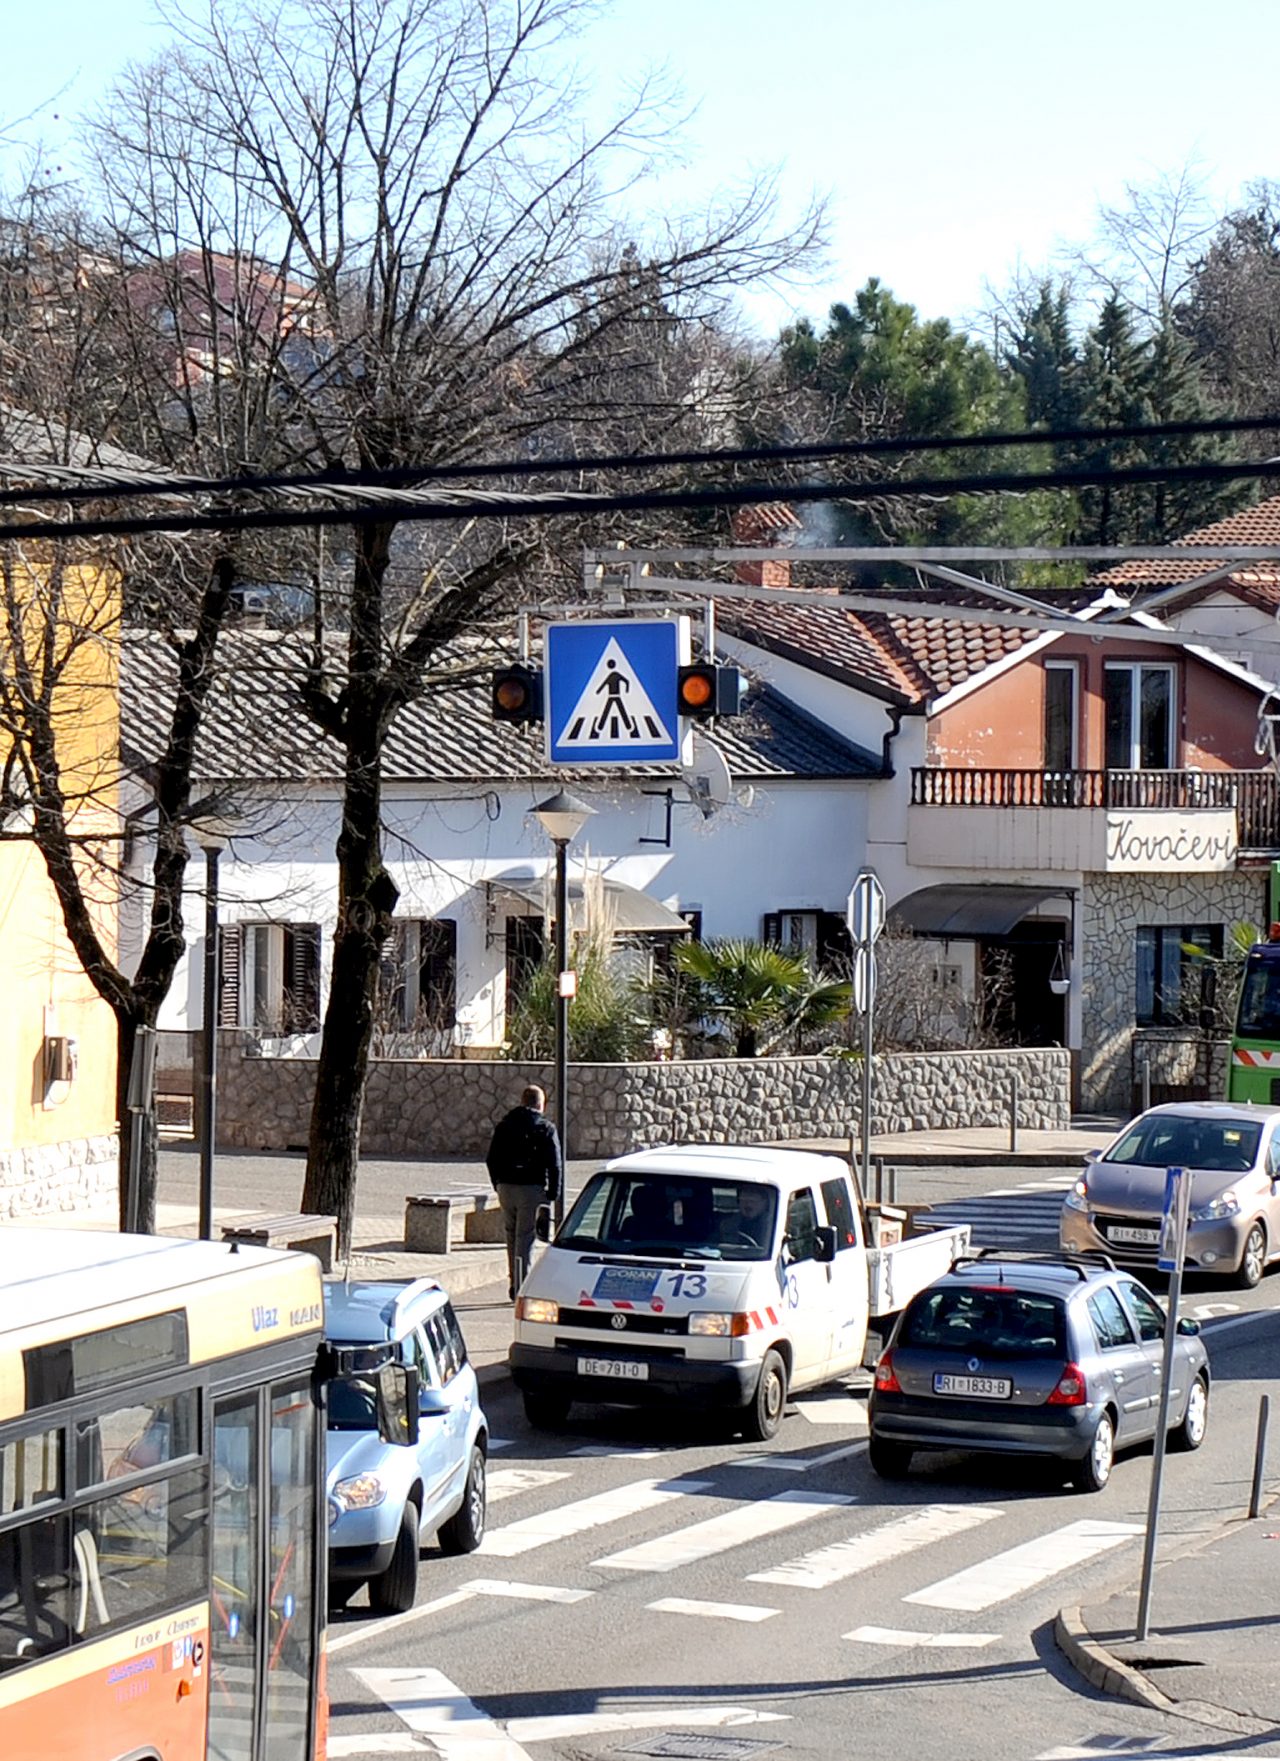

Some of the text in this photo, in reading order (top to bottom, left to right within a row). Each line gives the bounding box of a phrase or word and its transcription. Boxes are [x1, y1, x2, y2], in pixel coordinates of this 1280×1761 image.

[606, 1269, 656, 1280] GORAN
[667, 1273, 707, 1299] 13
[251, 1305, 279, 1332] Ulaz
